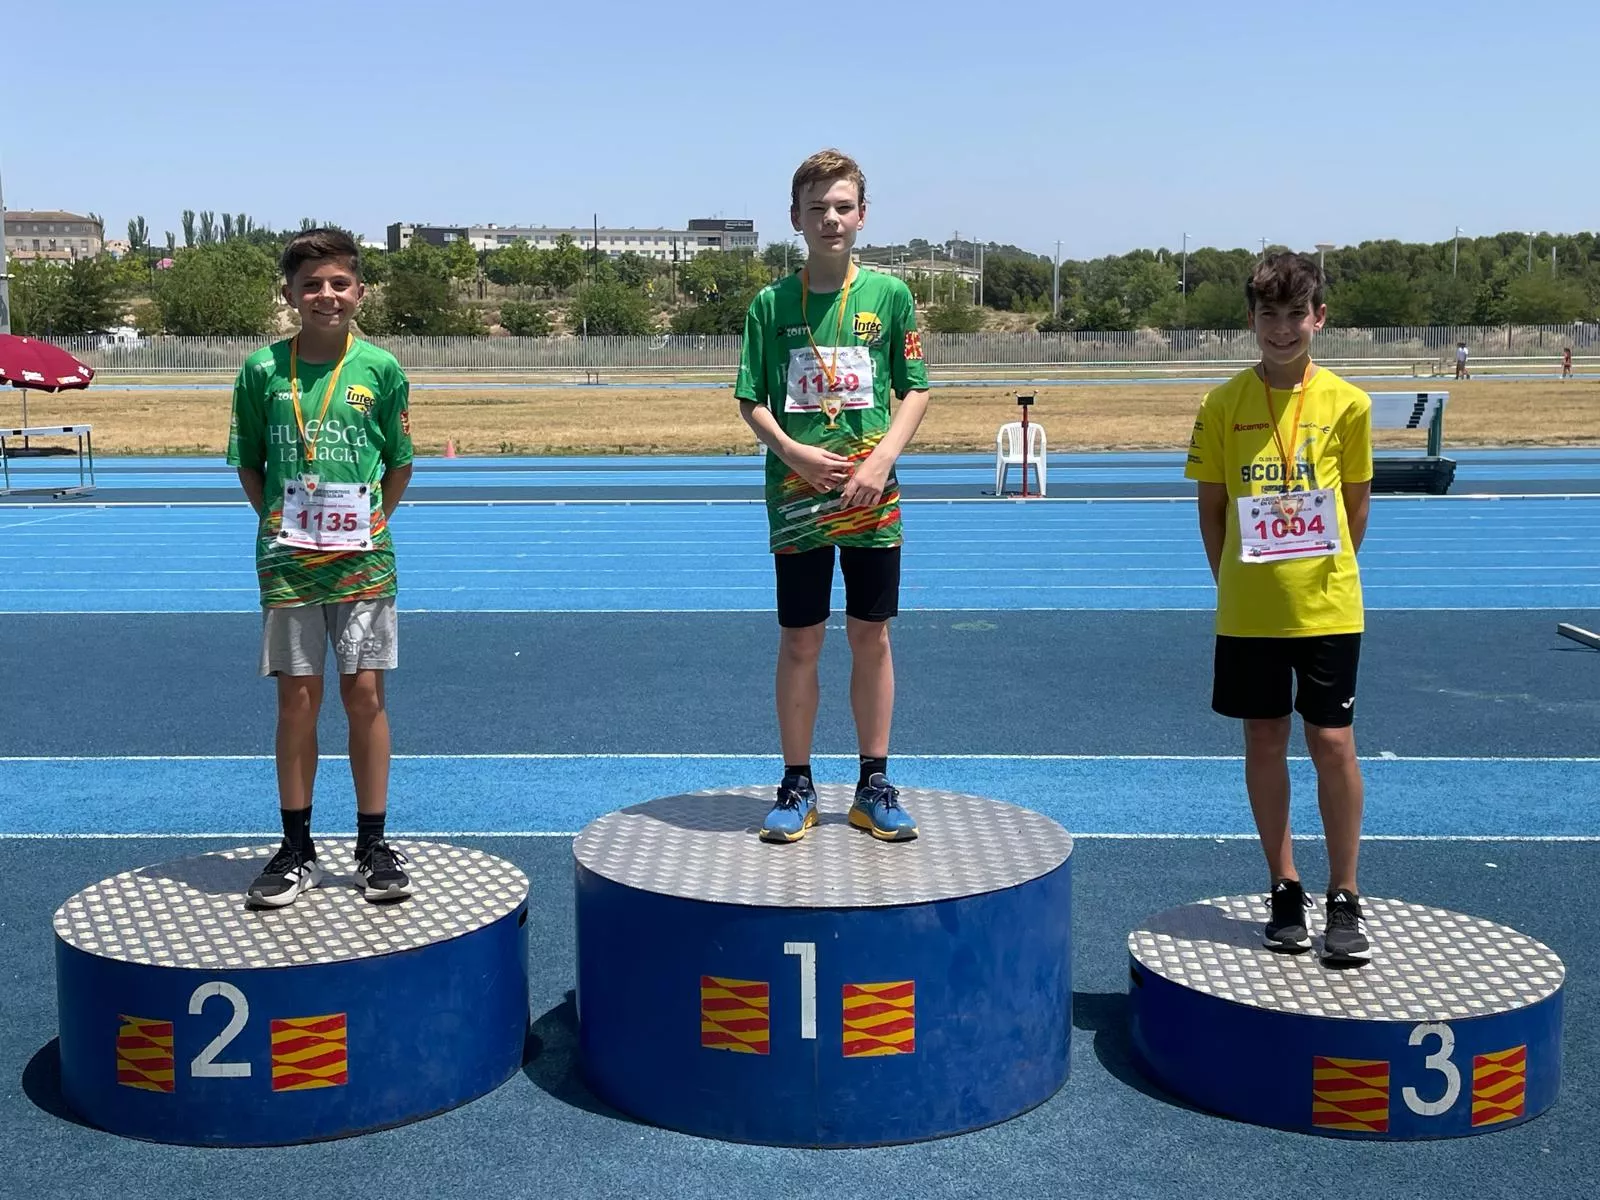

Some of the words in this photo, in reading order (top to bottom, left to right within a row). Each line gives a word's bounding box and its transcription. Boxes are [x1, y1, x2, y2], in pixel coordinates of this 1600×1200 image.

[798, 373, 859, 394] 1129
[297, 510, 357, 532] 1135
[1254, 514, 1326, 540] 1004
[784, 942, 816, 1039] 1
[188, 981, 251, 1077] 2
[1402, 1021, 1461, 1116] 3
